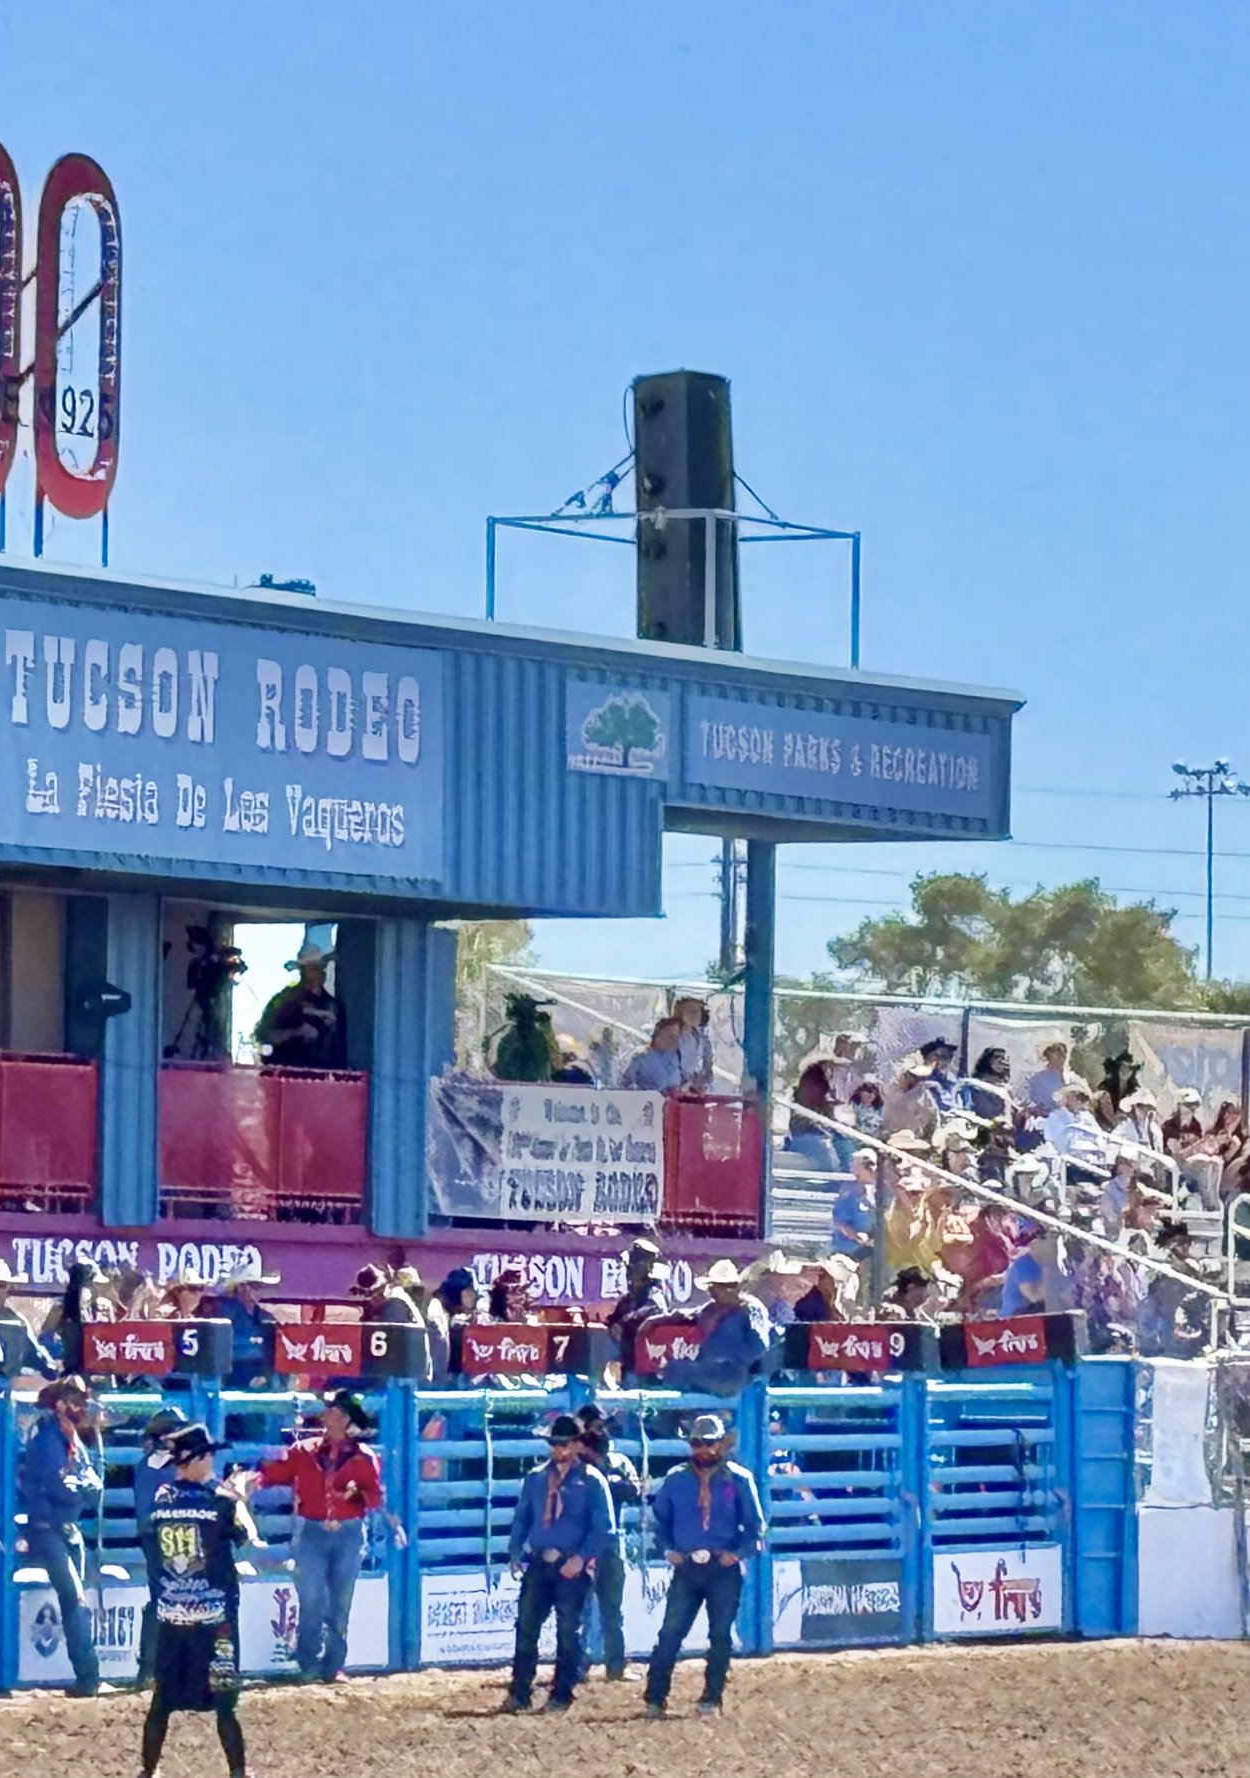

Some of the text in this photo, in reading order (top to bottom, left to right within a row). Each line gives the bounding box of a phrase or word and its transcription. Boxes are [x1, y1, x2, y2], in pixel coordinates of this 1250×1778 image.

[5, 628, 422, 764] TUCSON RODEO
[700, 721, 979, 792] TUCSON PARKS & RECREATION
[25, 758, 406, 852] La Fiesta De Los Vaqueros
[182, 1329, 199, 1357] 5
[370, 1331, 388, 1357] 6
[553, 1335, 570, 1362] 7
[889, 1332, 906, 1358] 9
